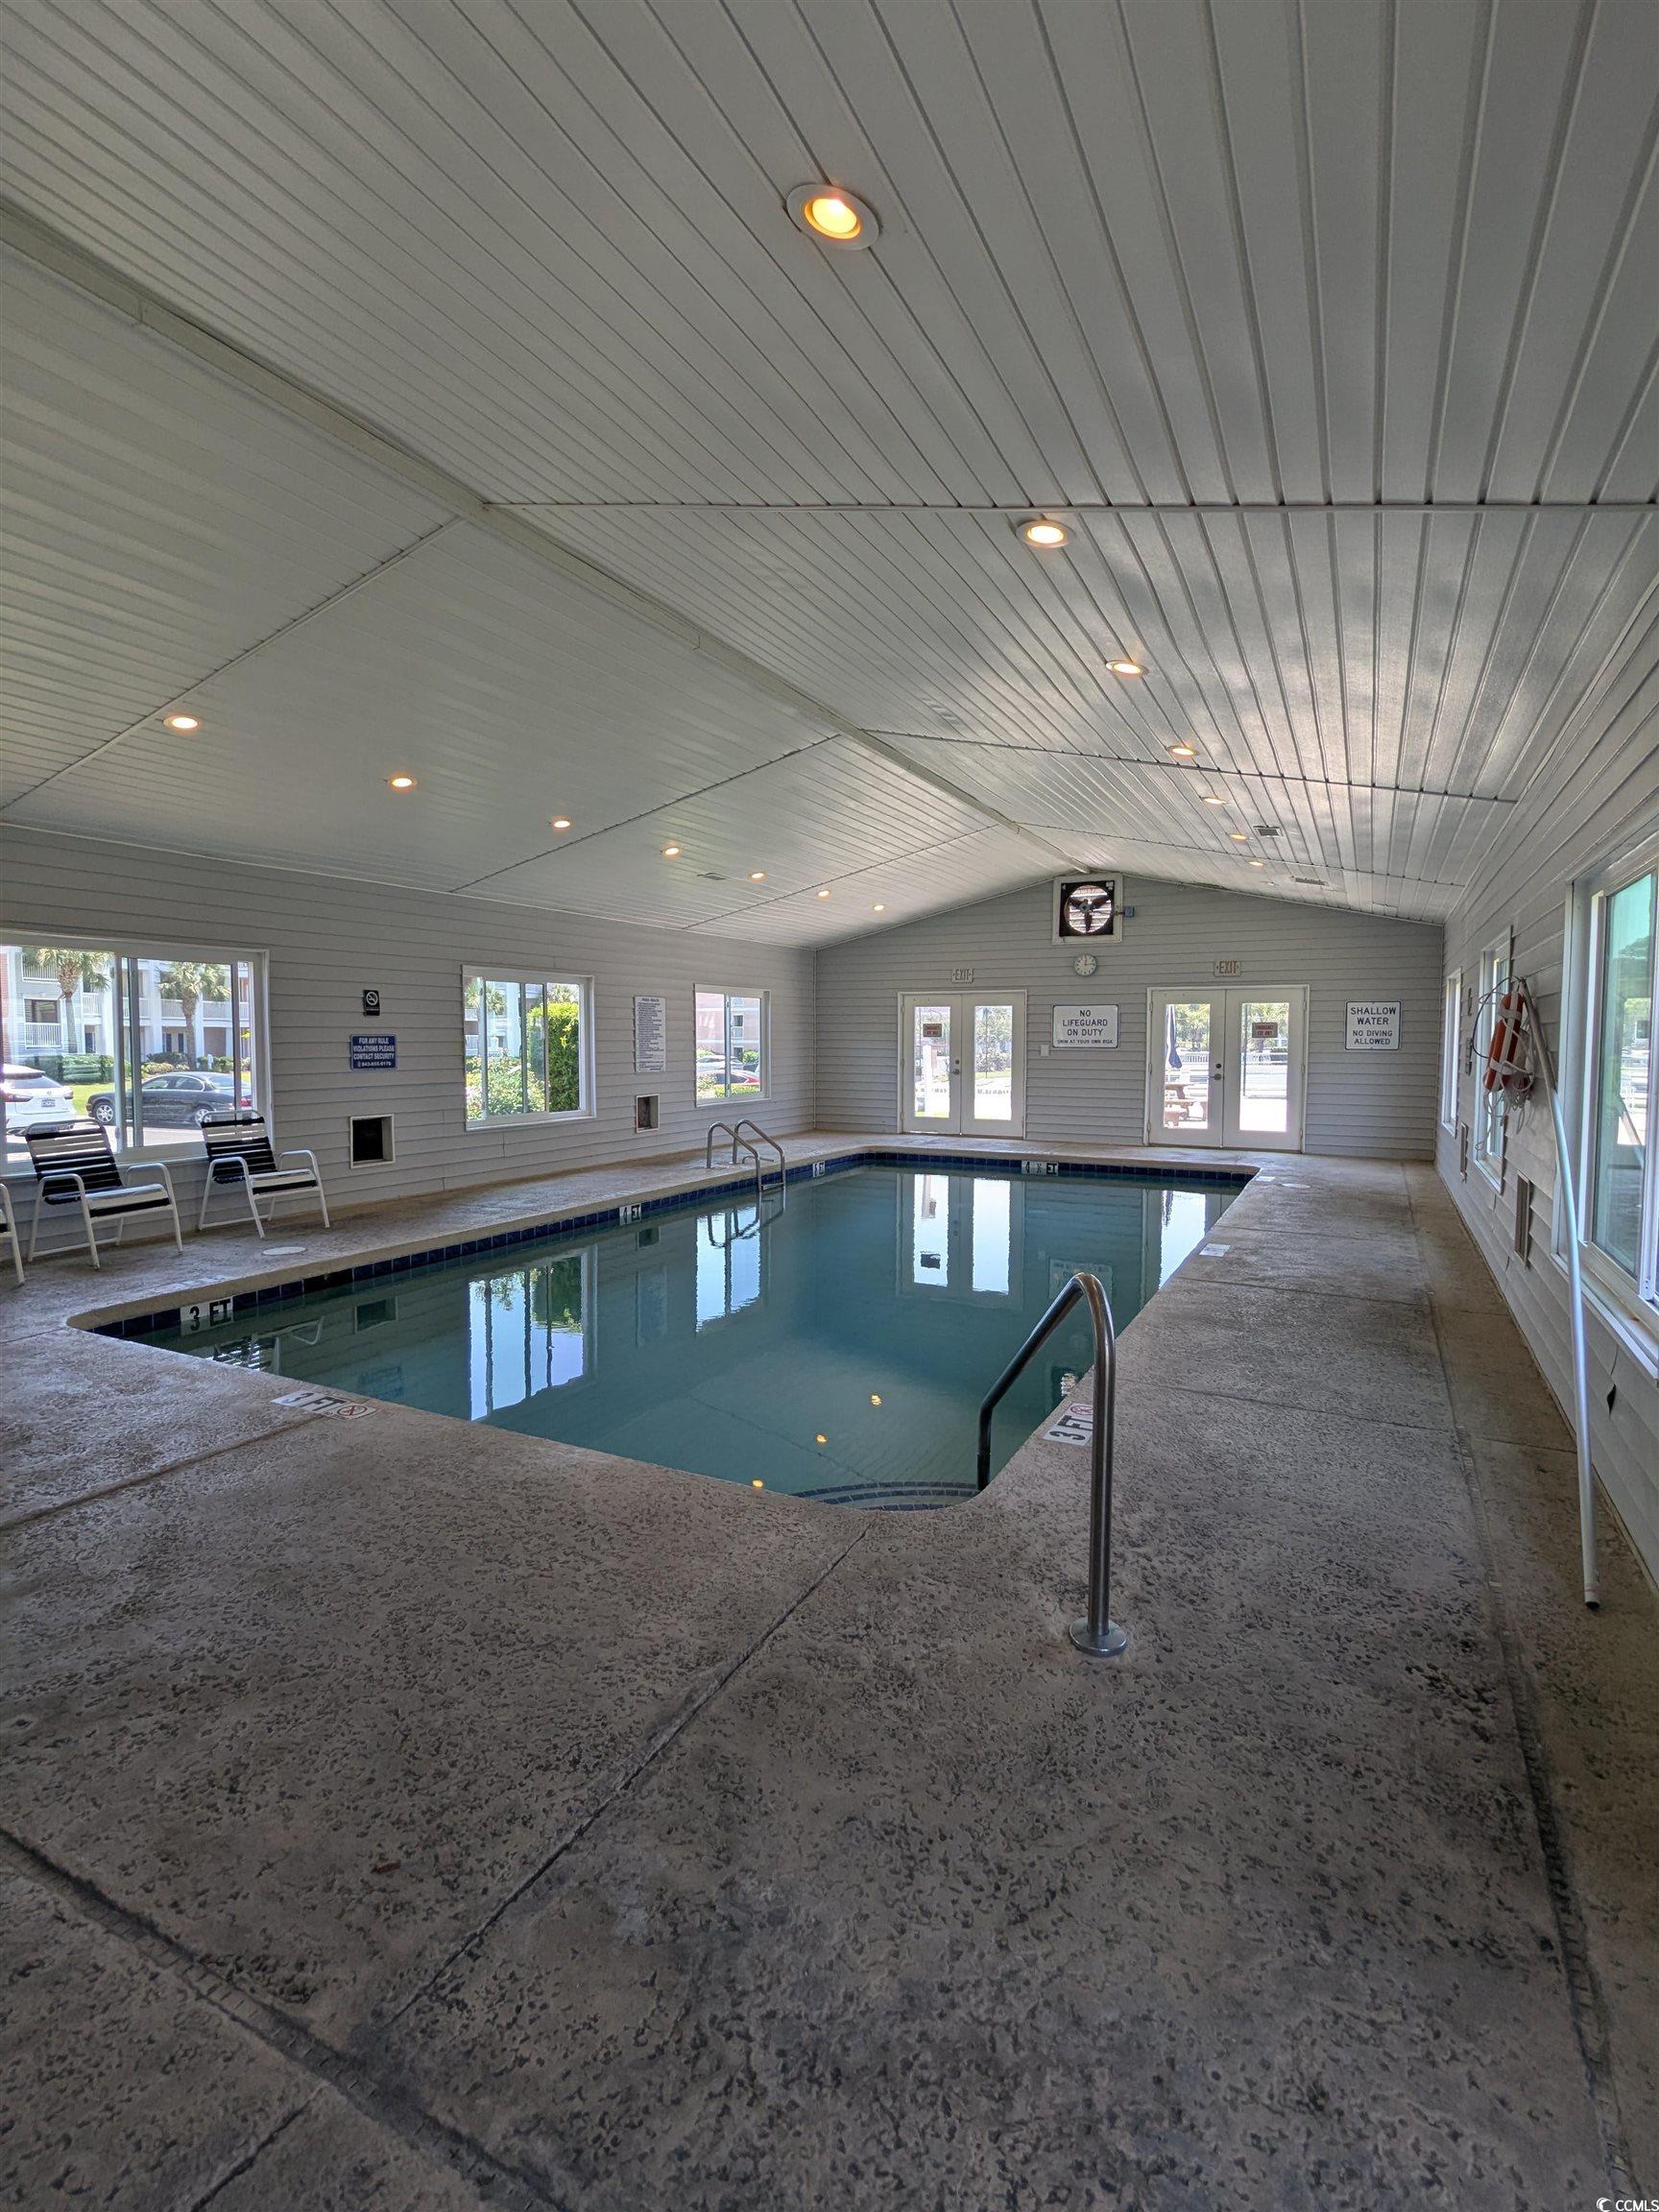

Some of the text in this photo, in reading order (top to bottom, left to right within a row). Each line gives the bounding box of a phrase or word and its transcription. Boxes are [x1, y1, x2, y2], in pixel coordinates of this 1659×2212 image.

[1218, 961, 1237, 974] EXIT
[955, 969, 971, 980] EXIT
[1350, 1006, 1397, 1015] SHALLOW
[1357, 1017, 1389, 1025] WATER
